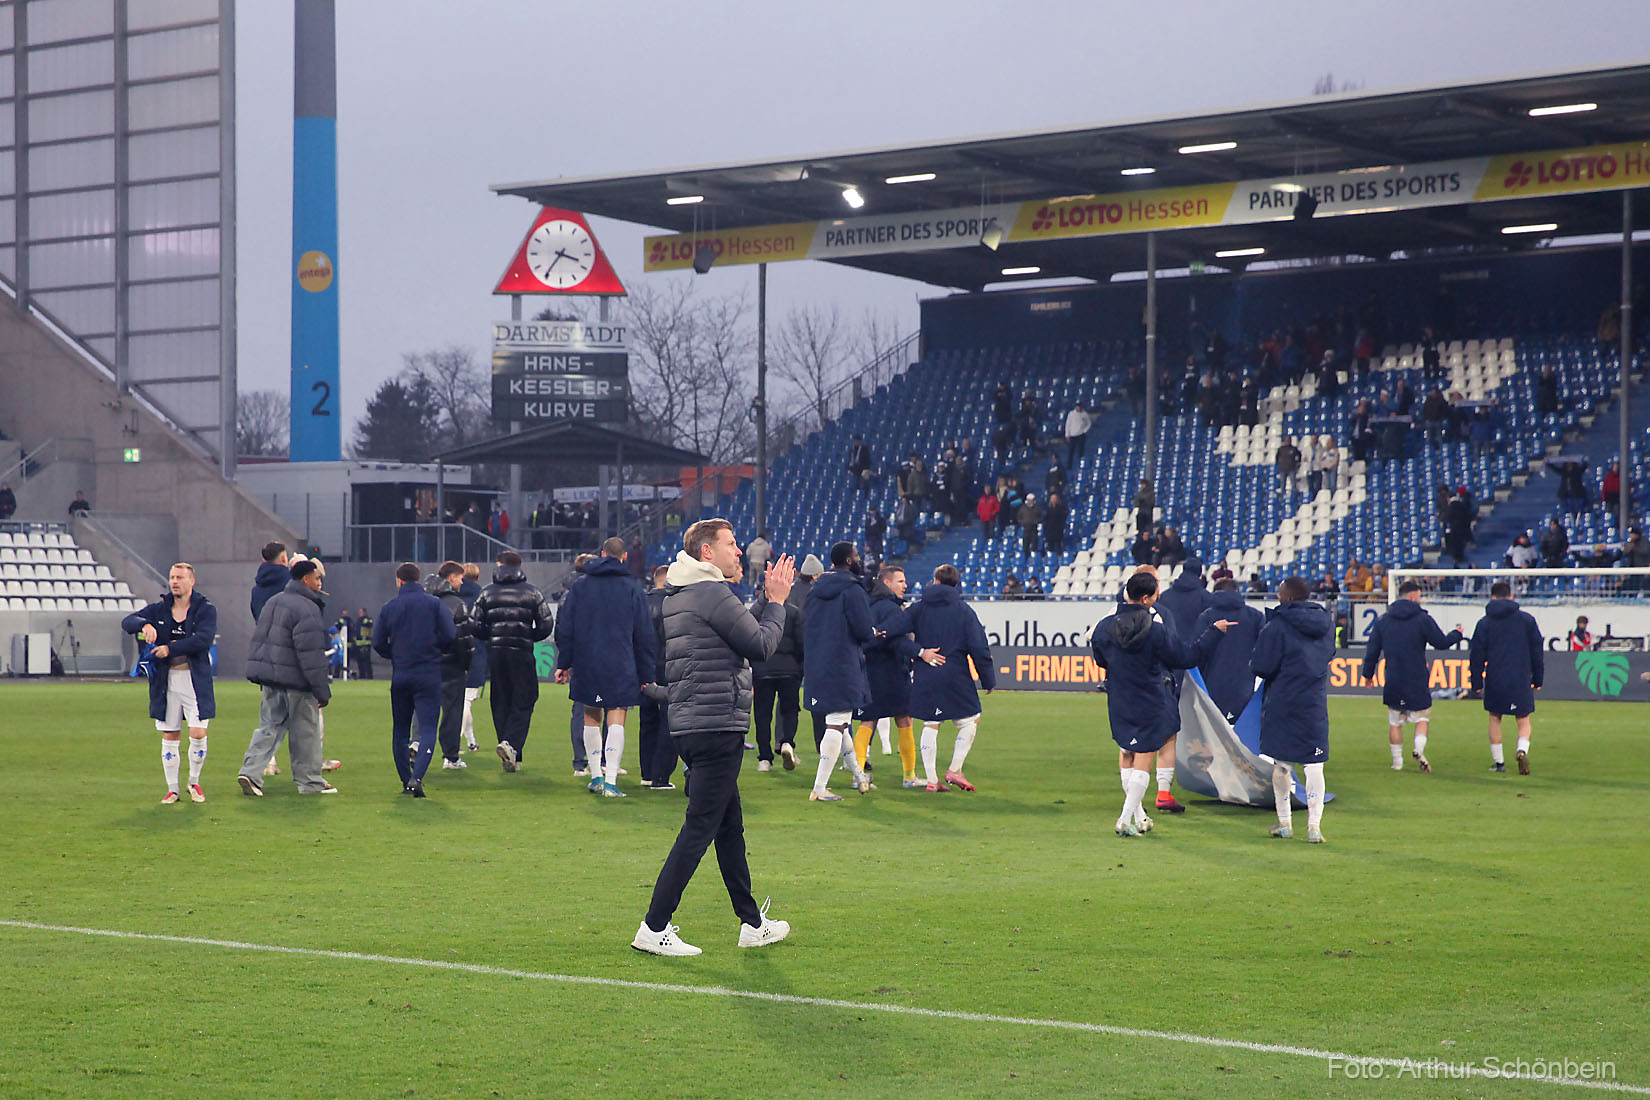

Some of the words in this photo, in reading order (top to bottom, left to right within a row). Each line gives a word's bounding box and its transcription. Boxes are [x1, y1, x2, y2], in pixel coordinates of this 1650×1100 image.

[1538, 154, 1617, 185] LOTTO
[1341, 180, 1378, 202] DES
[1384, 172, 1461, 198] SPORTS
[1058, 203, 1123, 228] LOTTO
[1129, 199, 1208, 222] Hessen
[728, 235, 796, 257] Hessen
[826, 225, 896, 247] PARTNER
[901, 221, 932, 241] DES
[495, 325, 627, 343] DARMSTADT
[523, 355, 594, 372] HANS-
[311, 380, 331, 417] 2
[509, 379, 623, 396] KESSLER-
[523, 402, 596, 418] KURVE
[1362, 608, 1380, 637] 2
